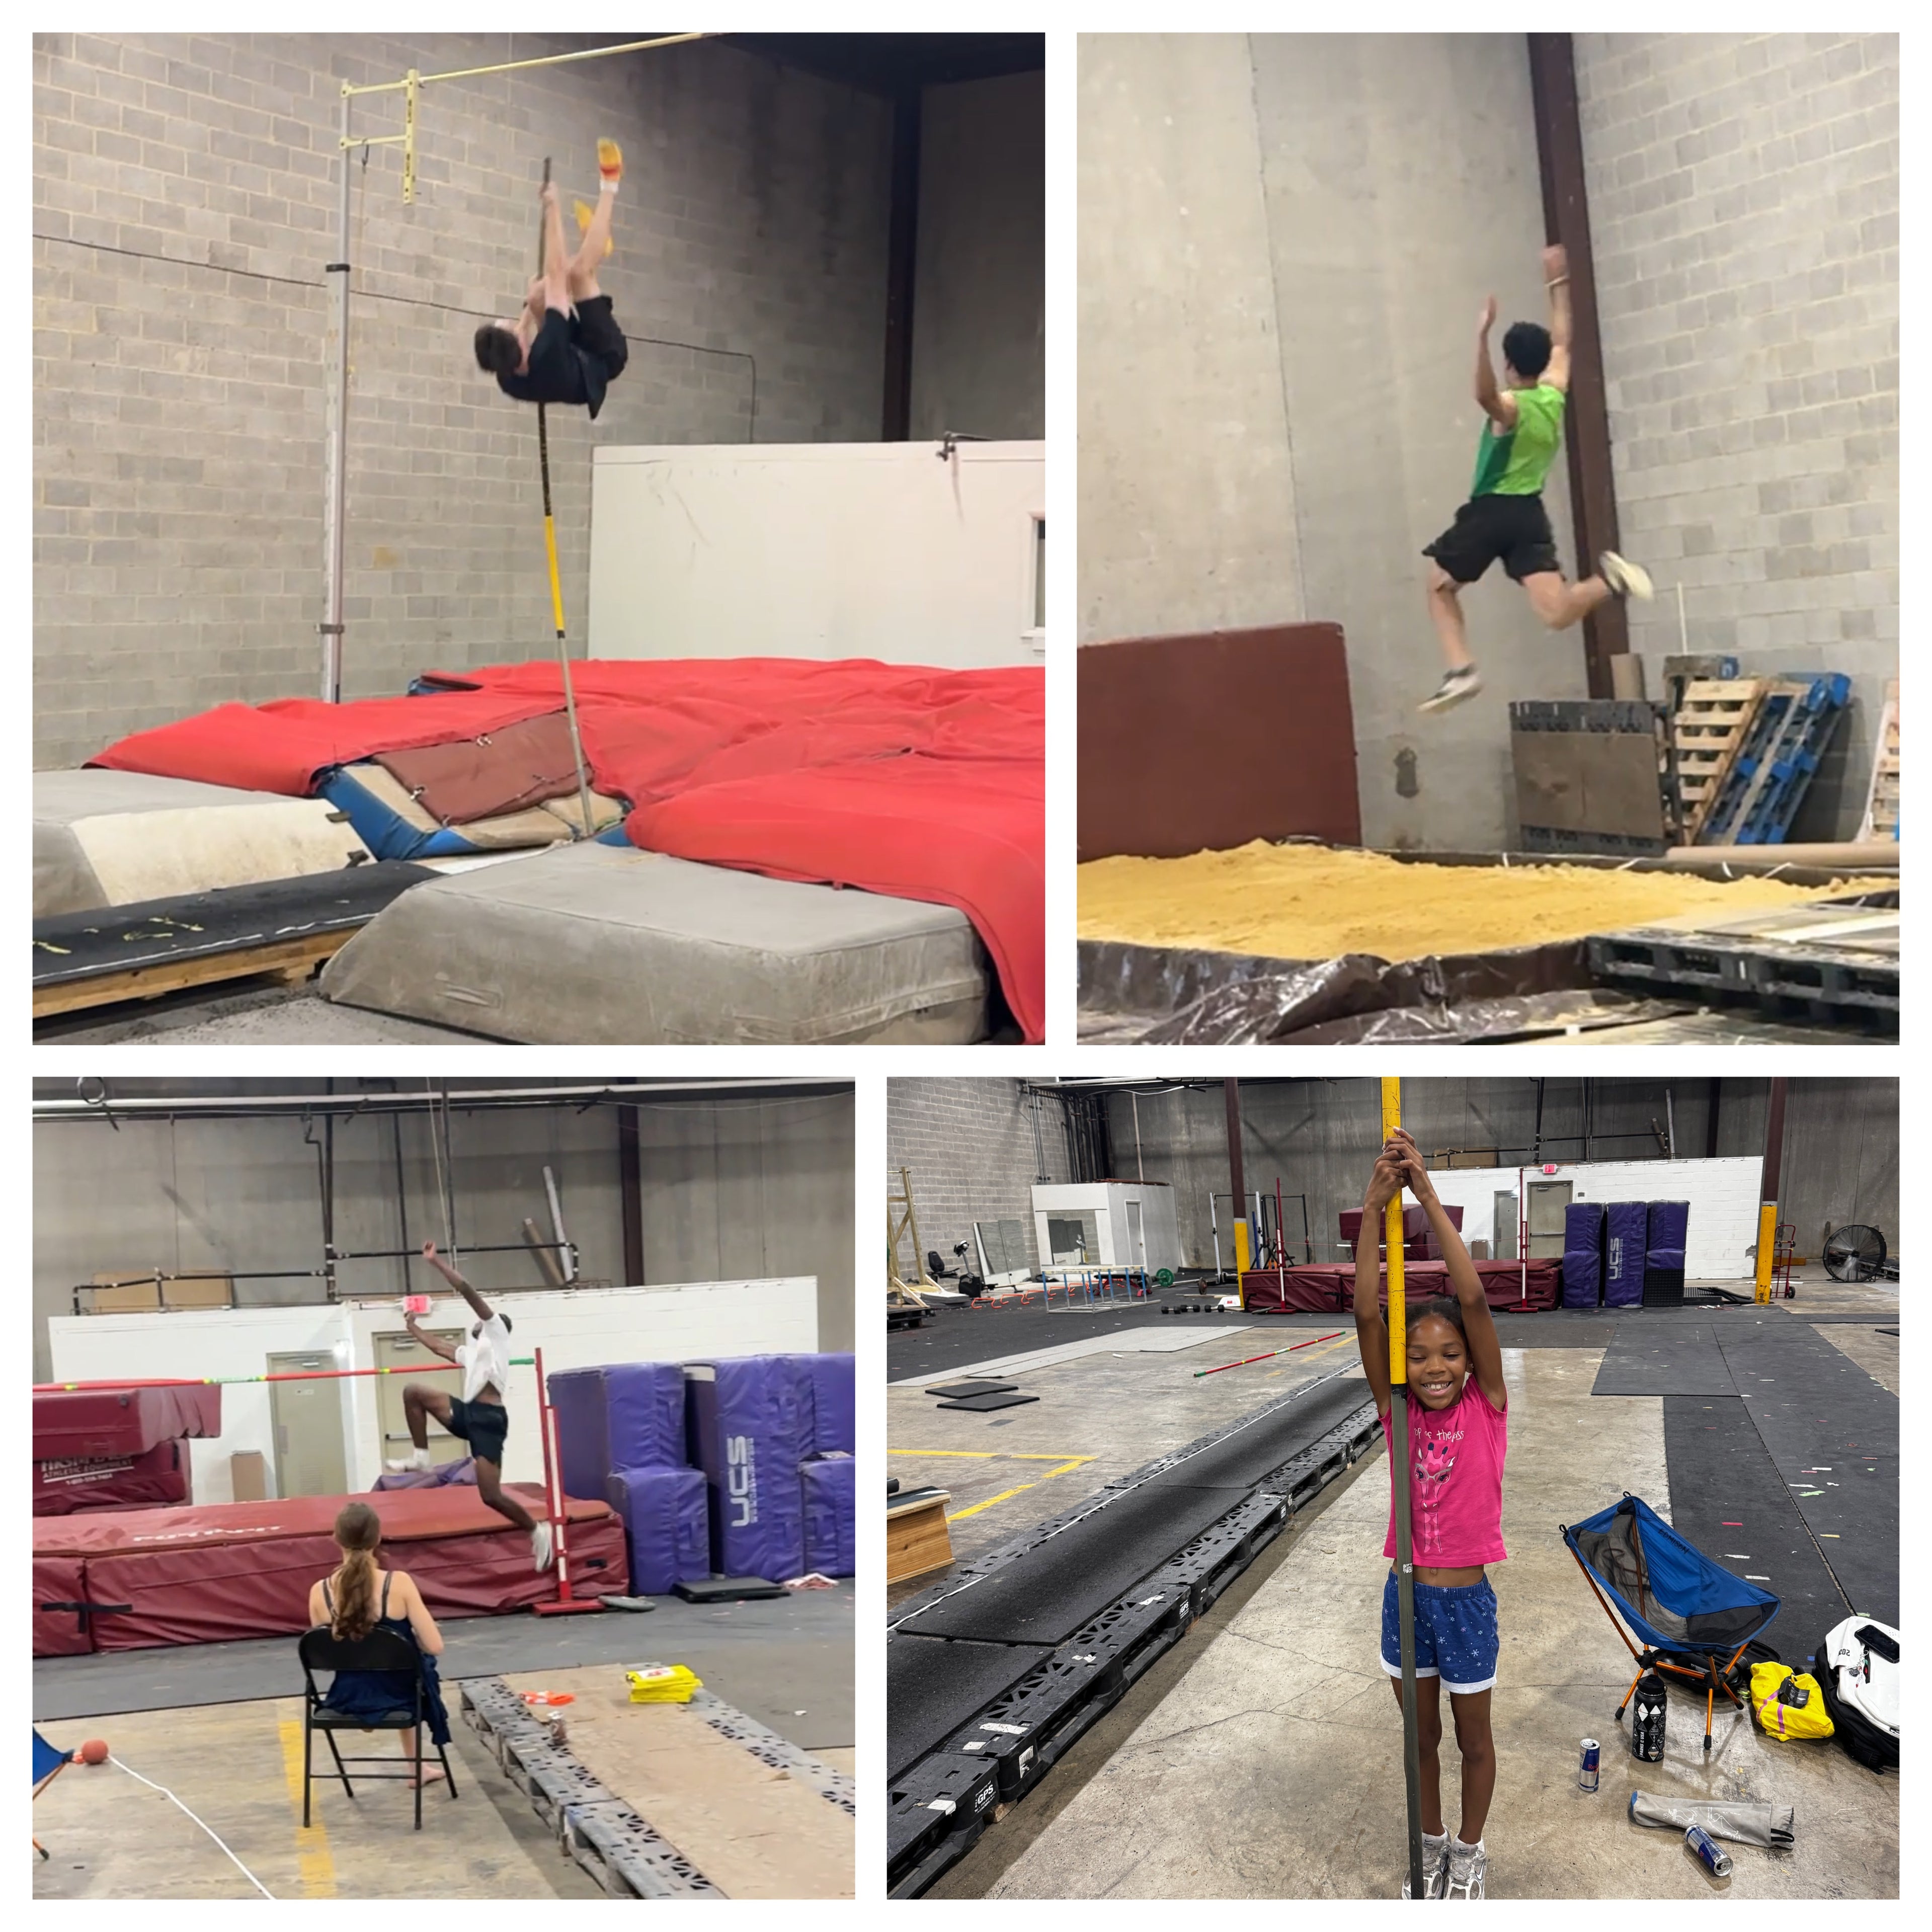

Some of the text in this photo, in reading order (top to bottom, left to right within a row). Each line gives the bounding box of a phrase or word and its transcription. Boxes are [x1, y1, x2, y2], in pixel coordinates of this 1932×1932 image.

[1609, 1238, 1619, 1279] UCS
[1436, 1429, 1452, 1441] the
[727, 1436, 750, 1526] UCS
[975, 1784, 994, 1808] iGPS
